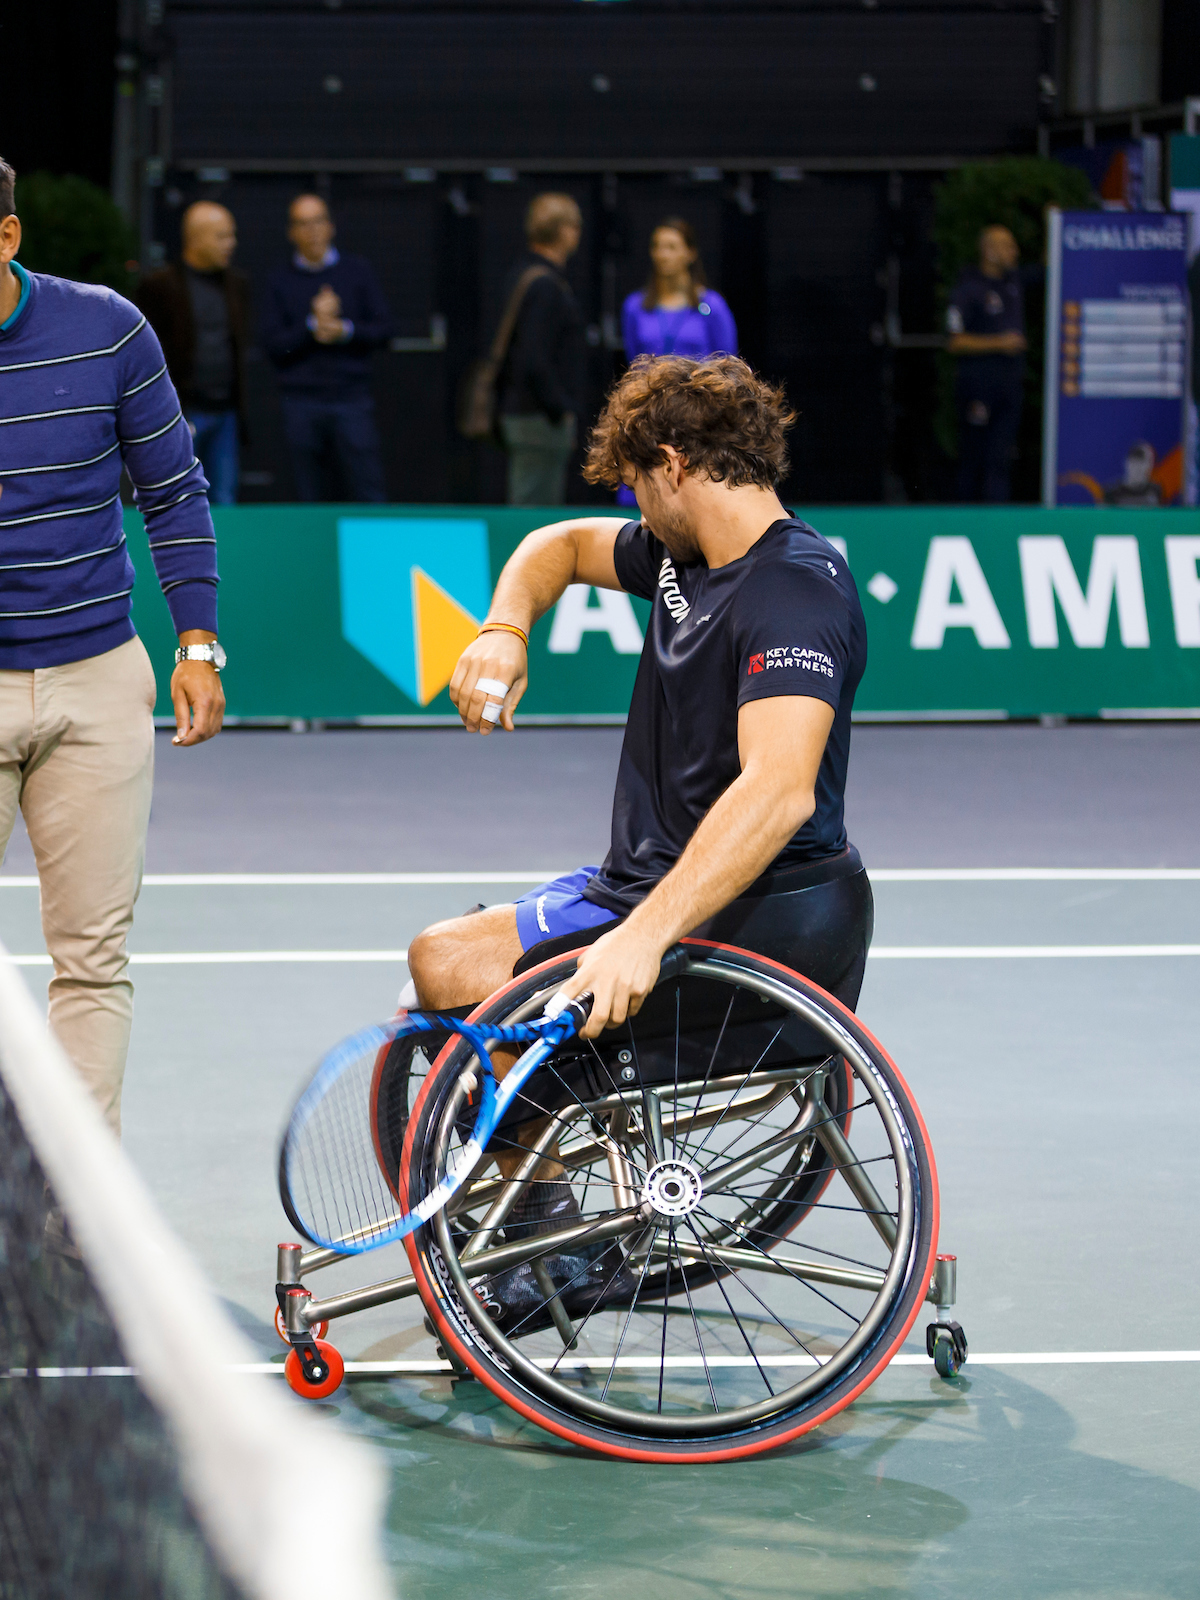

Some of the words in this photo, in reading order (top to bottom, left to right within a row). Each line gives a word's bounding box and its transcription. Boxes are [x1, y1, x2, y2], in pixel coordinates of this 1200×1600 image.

[766, 646, 790, 659] KEY
[791, 646, 834, 668] CAPITAL
[766, 657, 834, 678] PARTNERS
